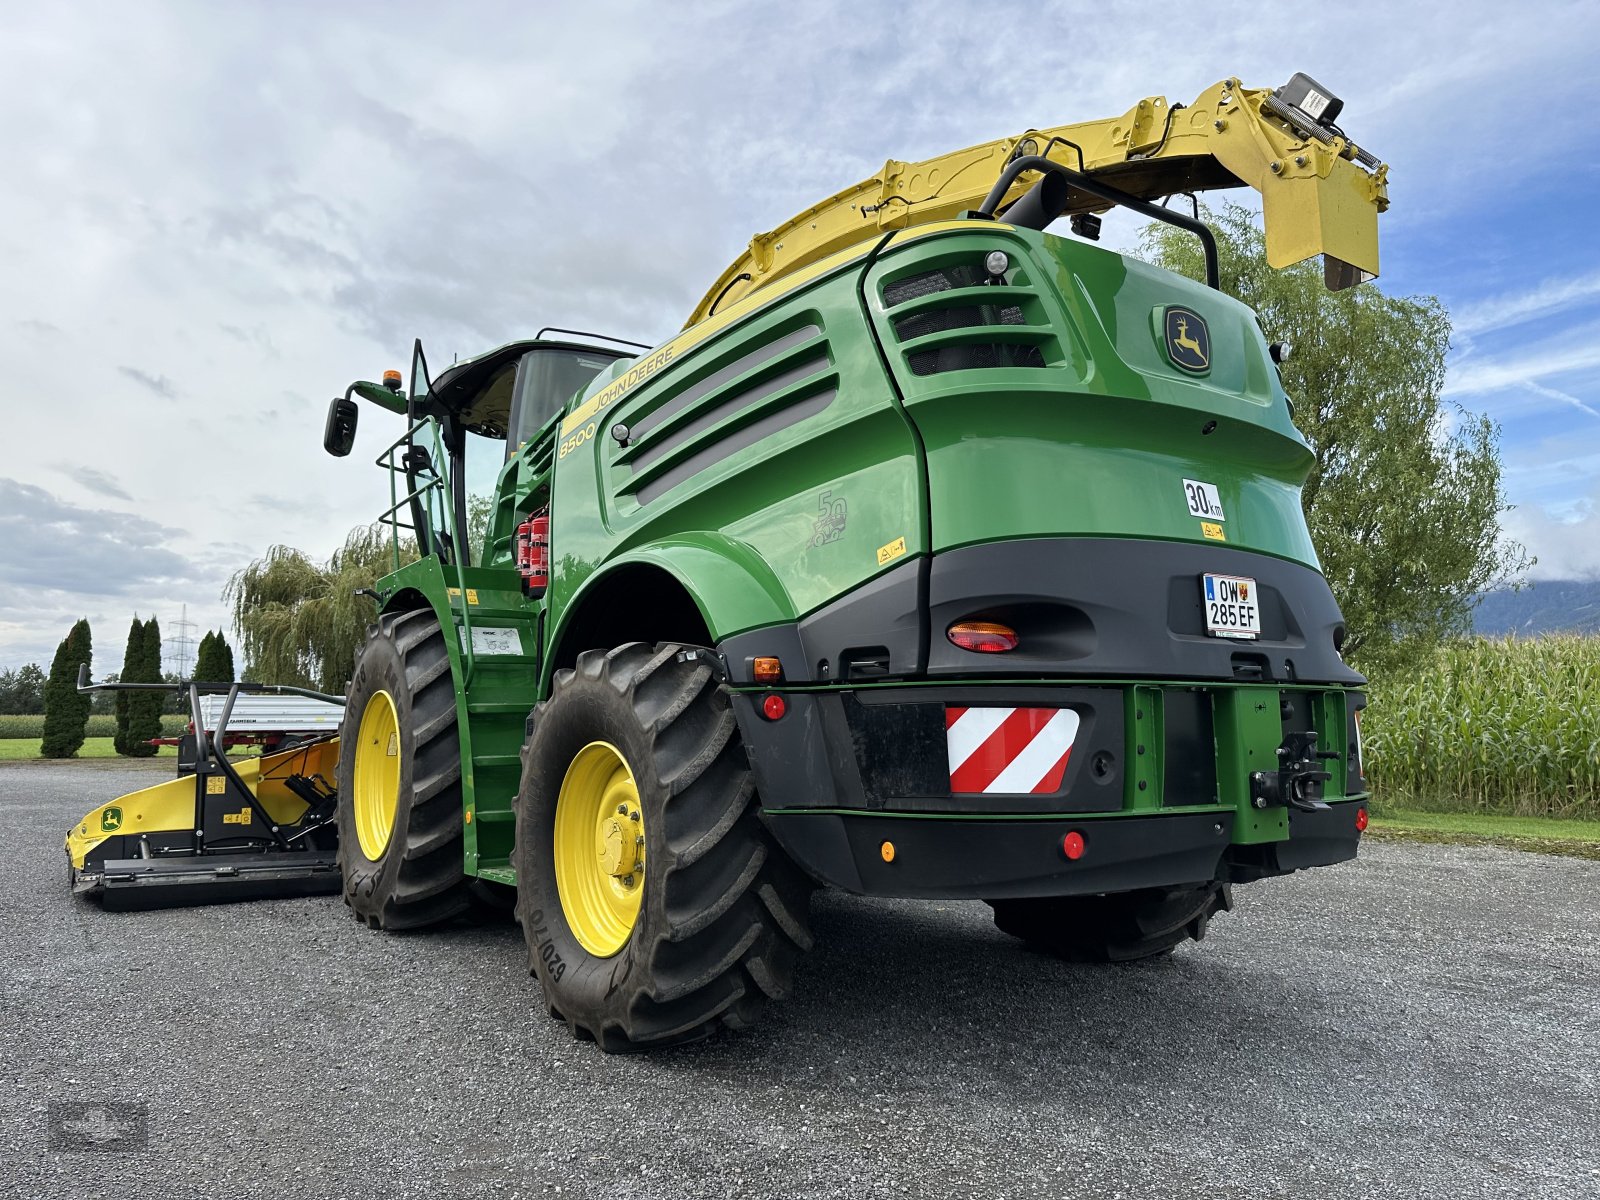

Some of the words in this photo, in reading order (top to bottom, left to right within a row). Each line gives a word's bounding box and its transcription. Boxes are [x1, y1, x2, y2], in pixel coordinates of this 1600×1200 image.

[594, 381, 626, 413] JOHN
[627, 346, 674, 388] DEERE
[559, 422, 596, 460] 8500
[1186, 483, 1209, 515] 30
[1208, 500, 1223, 517] km
[1219, 580, 1238, 603] OW
[1210, 602, 1237, 626] 285
[1239, 605, 1254, 628] EF
[530, 909, 568, 984] 620/70
